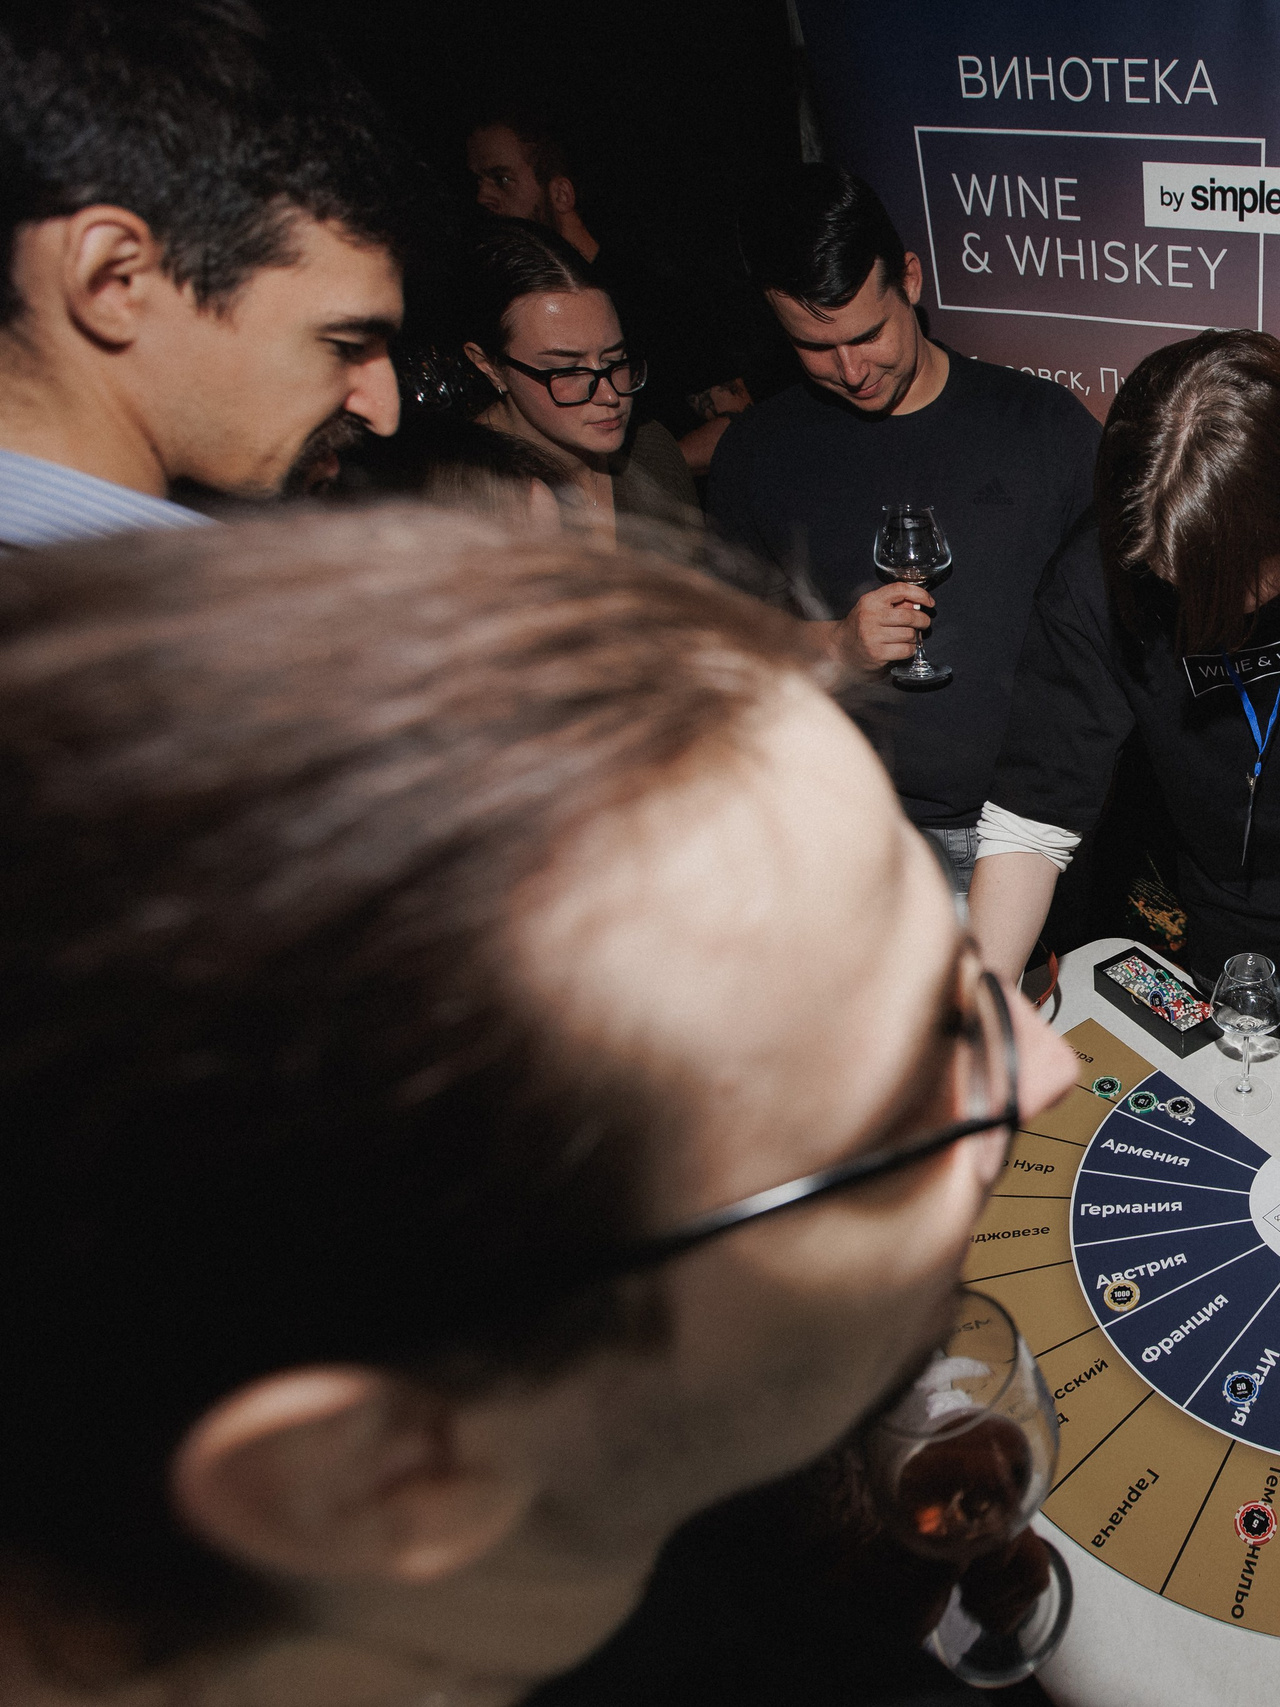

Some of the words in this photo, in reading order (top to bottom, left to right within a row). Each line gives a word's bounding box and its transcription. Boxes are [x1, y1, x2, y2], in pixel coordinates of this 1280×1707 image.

[958, 55, 1218, 106] ВИНОТЕКА
[952, 172, 1081, 222] WINE
[1160, 186, 1185, 212] by
[962, 232, 993, 274] &
[1005, 234, 1228, 290] WHISKEY
[1258, 656, 1272, 667] &
[1013, 1159, 1055, 1174] Нуар
[1100, 1138, 1191, 1167] Армения
[1080, 1201, 1183, 1217] Германия
[1096, 1253, 1188, 1289] Австрия
[1114, 1290, 1131, 1298] 1000
[1141, 1294, 1229, 1363] Франция
[1053, 1358, 1109, 1400] сский
[1236, 1382, 1246, 1391] 50
[1091, 1468, 1160, 1548] Гарнача
[1252, 1519, 1260, 1528] 5
